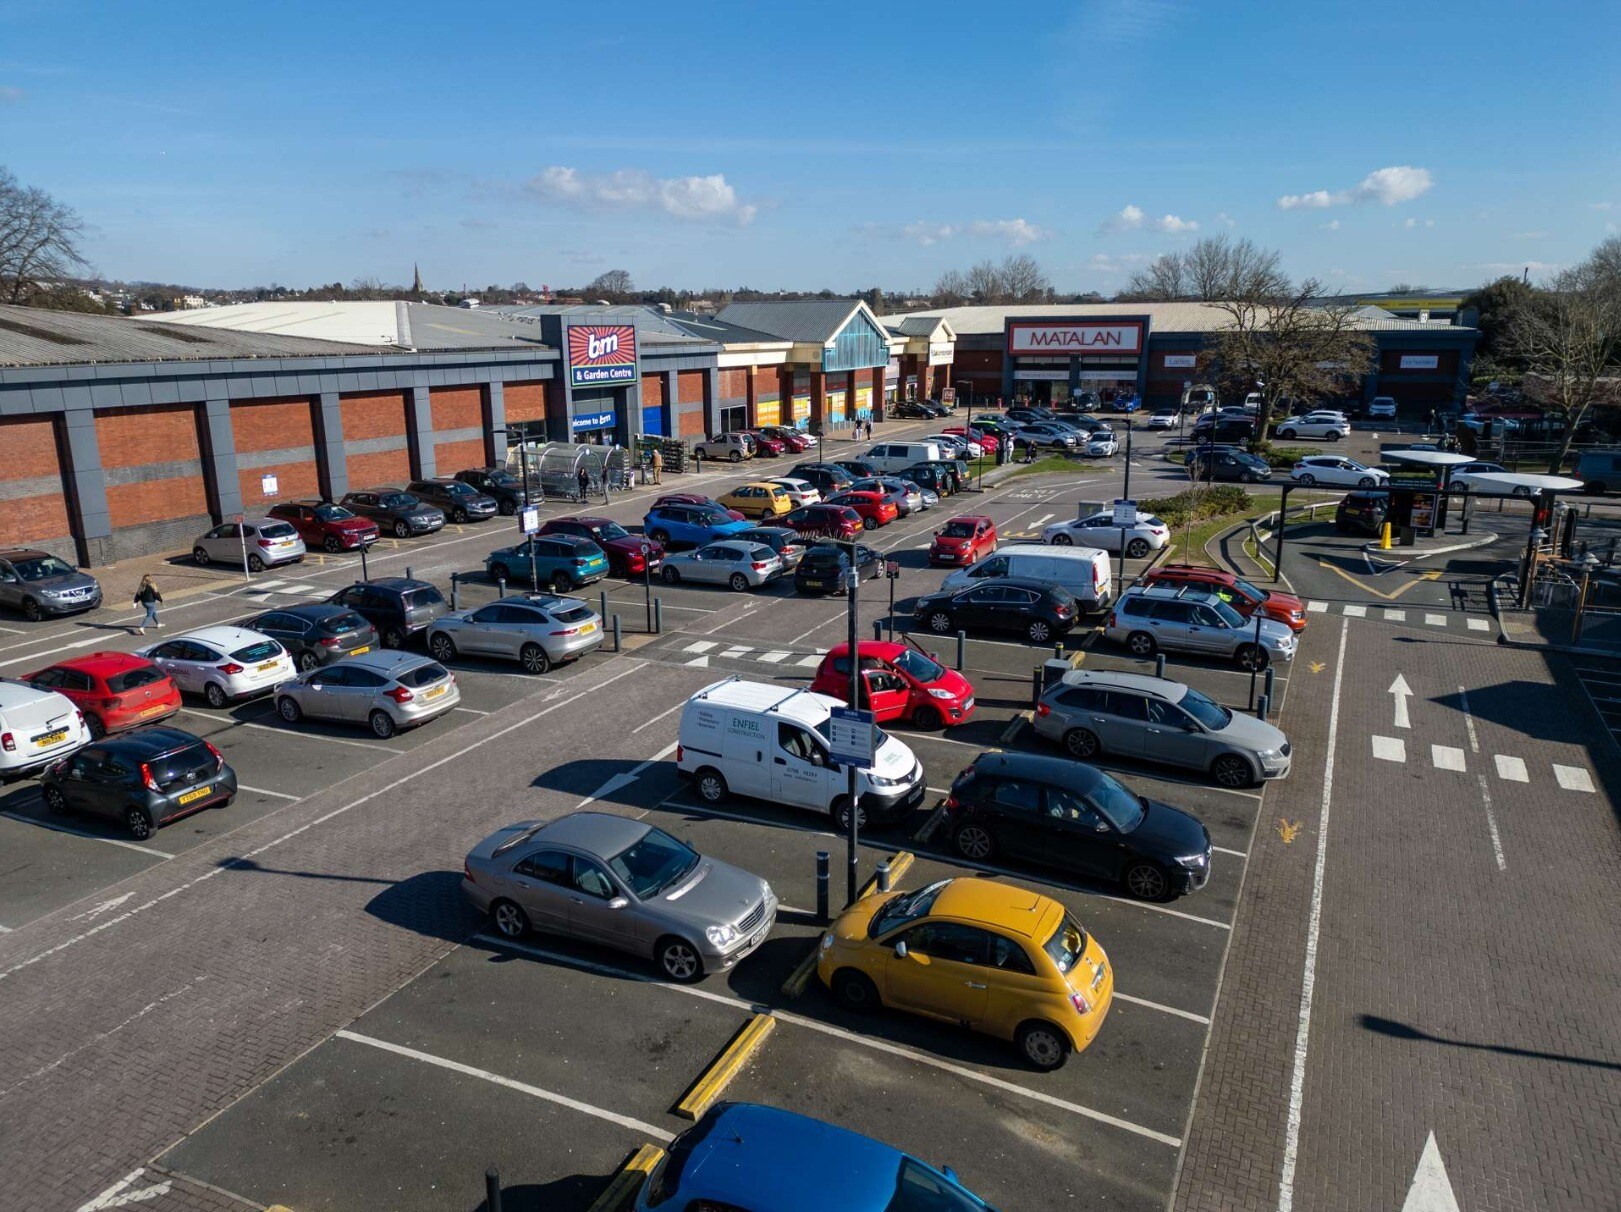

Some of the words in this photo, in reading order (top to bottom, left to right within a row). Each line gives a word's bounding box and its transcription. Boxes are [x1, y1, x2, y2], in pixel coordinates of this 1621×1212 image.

[1029, 331, 1121, 346] MATALAN
[584, 369, 609, 380] Garden
[610, 369, 632, 379] Centre
[592, 417, 599, 425] to
